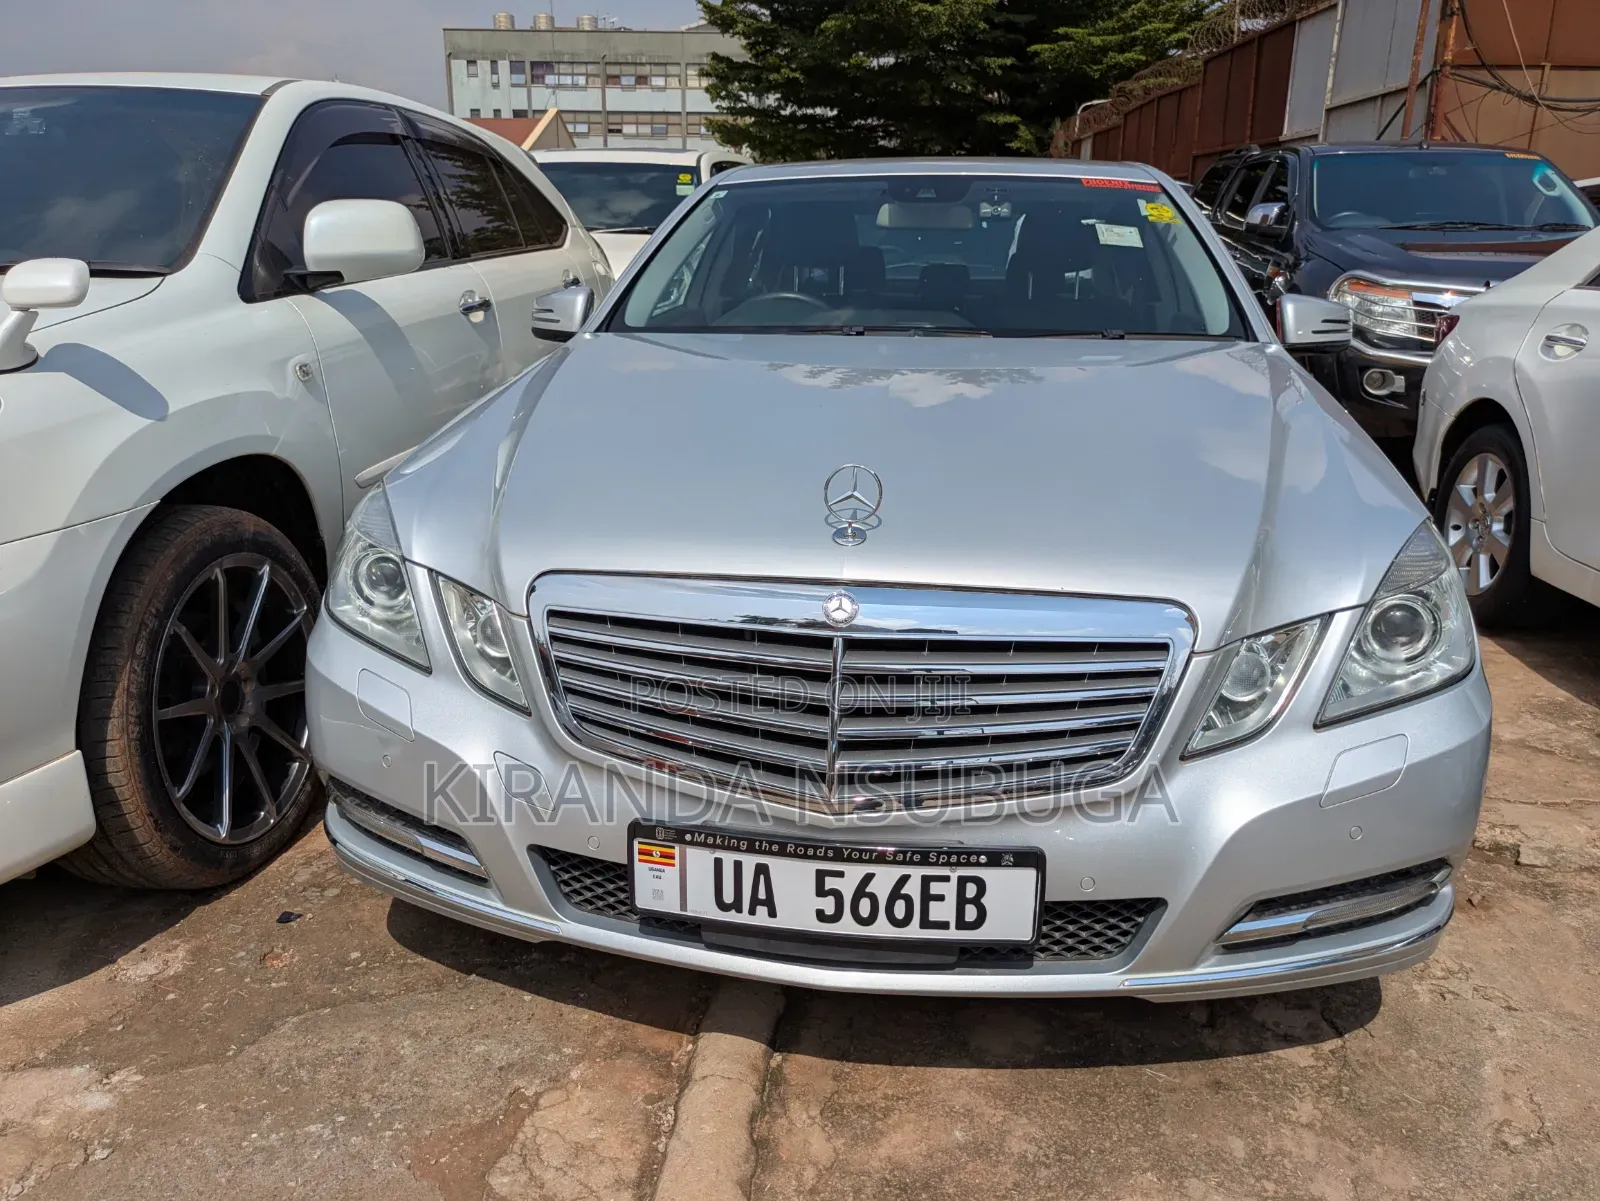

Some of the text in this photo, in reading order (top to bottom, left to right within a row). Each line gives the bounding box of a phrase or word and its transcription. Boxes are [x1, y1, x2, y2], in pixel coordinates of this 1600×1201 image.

[693, 832, 748, 850] Making
[755, 840, 780, 852] the
[787, 843, 834, 857] Roads
[843, 848, 878, 860] Your
[886, 849, 921, 862] Safe
[929, 852, 977, 865] Space
[713, 856, 988, 932] UA 566EB
